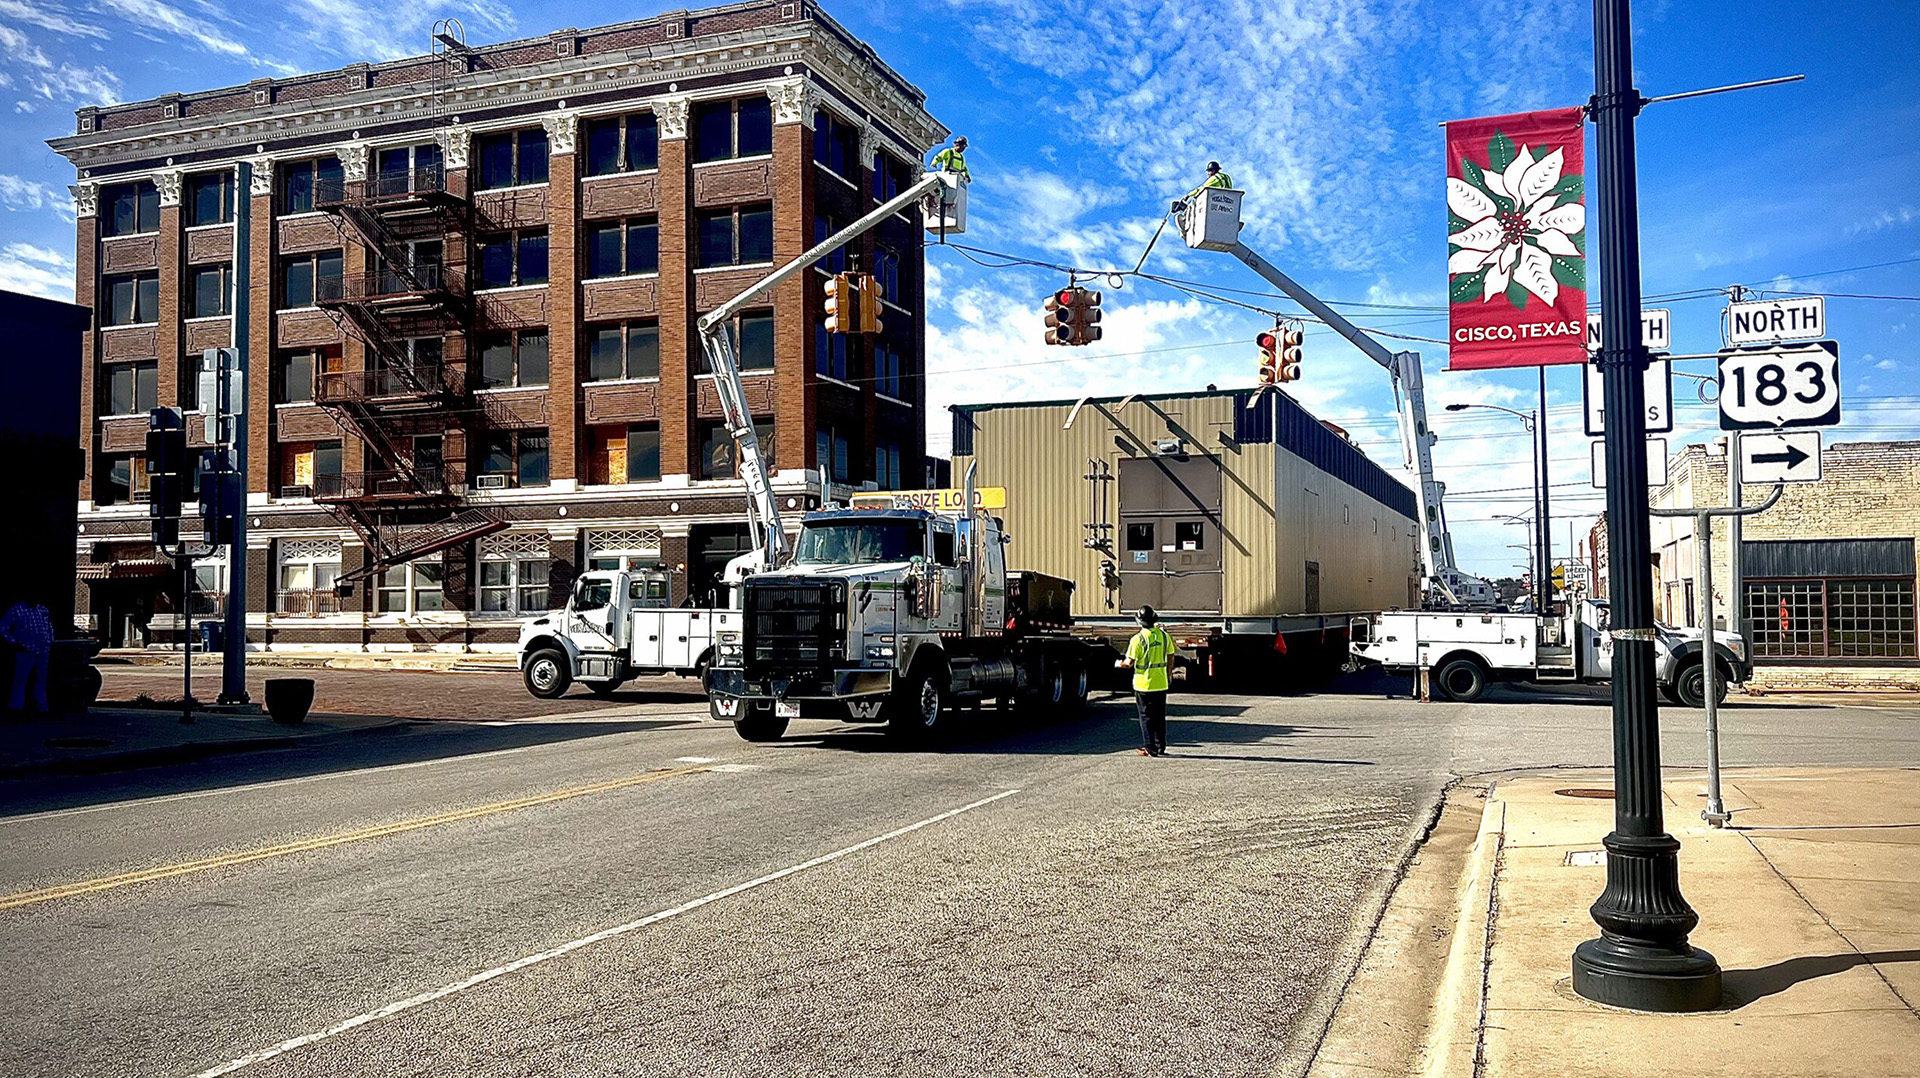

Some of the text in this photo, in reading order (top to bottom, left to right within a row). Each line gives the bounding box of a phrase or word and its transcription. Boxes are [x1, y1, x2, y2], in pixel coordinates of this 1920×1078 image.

[1455, 325, 1517, 342] CISCO,
[1518, 320, 1581, 338] TEXAS
[1735, 306, 1817, 334] NORTH
[1732, 361, 1826, 407] 183
[945, 491, 982, 507] LOD
